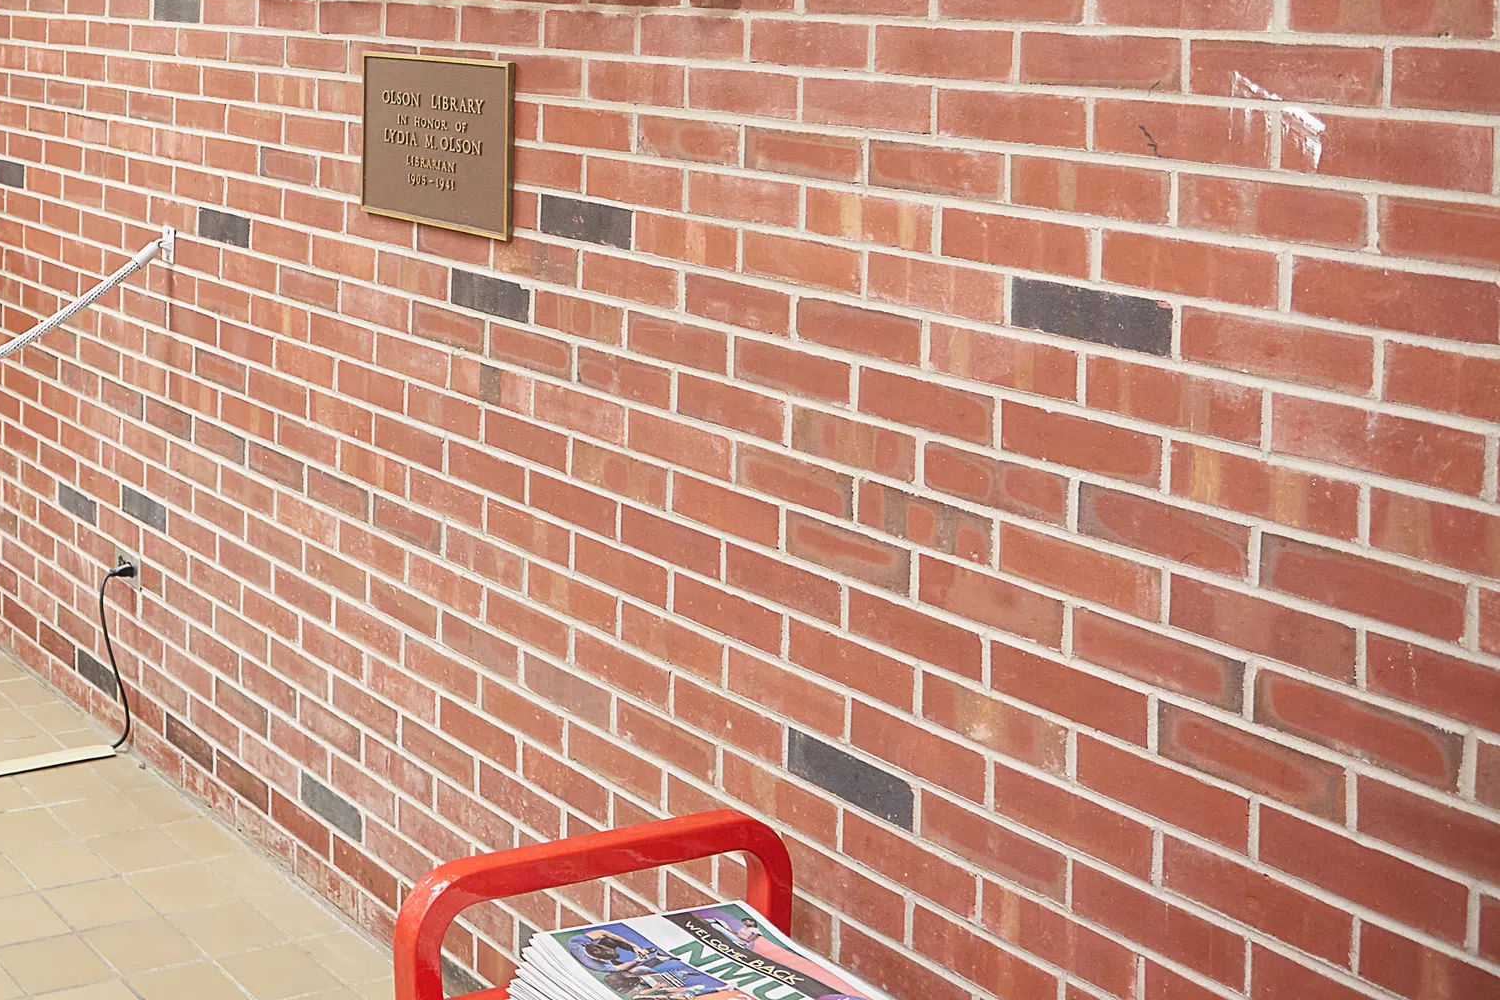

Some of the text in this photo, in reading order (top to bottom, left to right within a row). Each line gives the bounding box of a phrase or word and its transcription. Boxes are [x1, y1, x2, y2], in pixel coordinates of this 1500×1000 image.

[381, 89, 485, 115] OLSON LIBRARY
[397, 114, 468, 133] IN HONOR OF
[384, 128, 483, 156] LYDIA M. OLSON
[406, 154, 456, 174] LIBRARIAN
[684, 920, 804, 986] WELCOME BACK
[669, 939, 806, 1000] NMU
